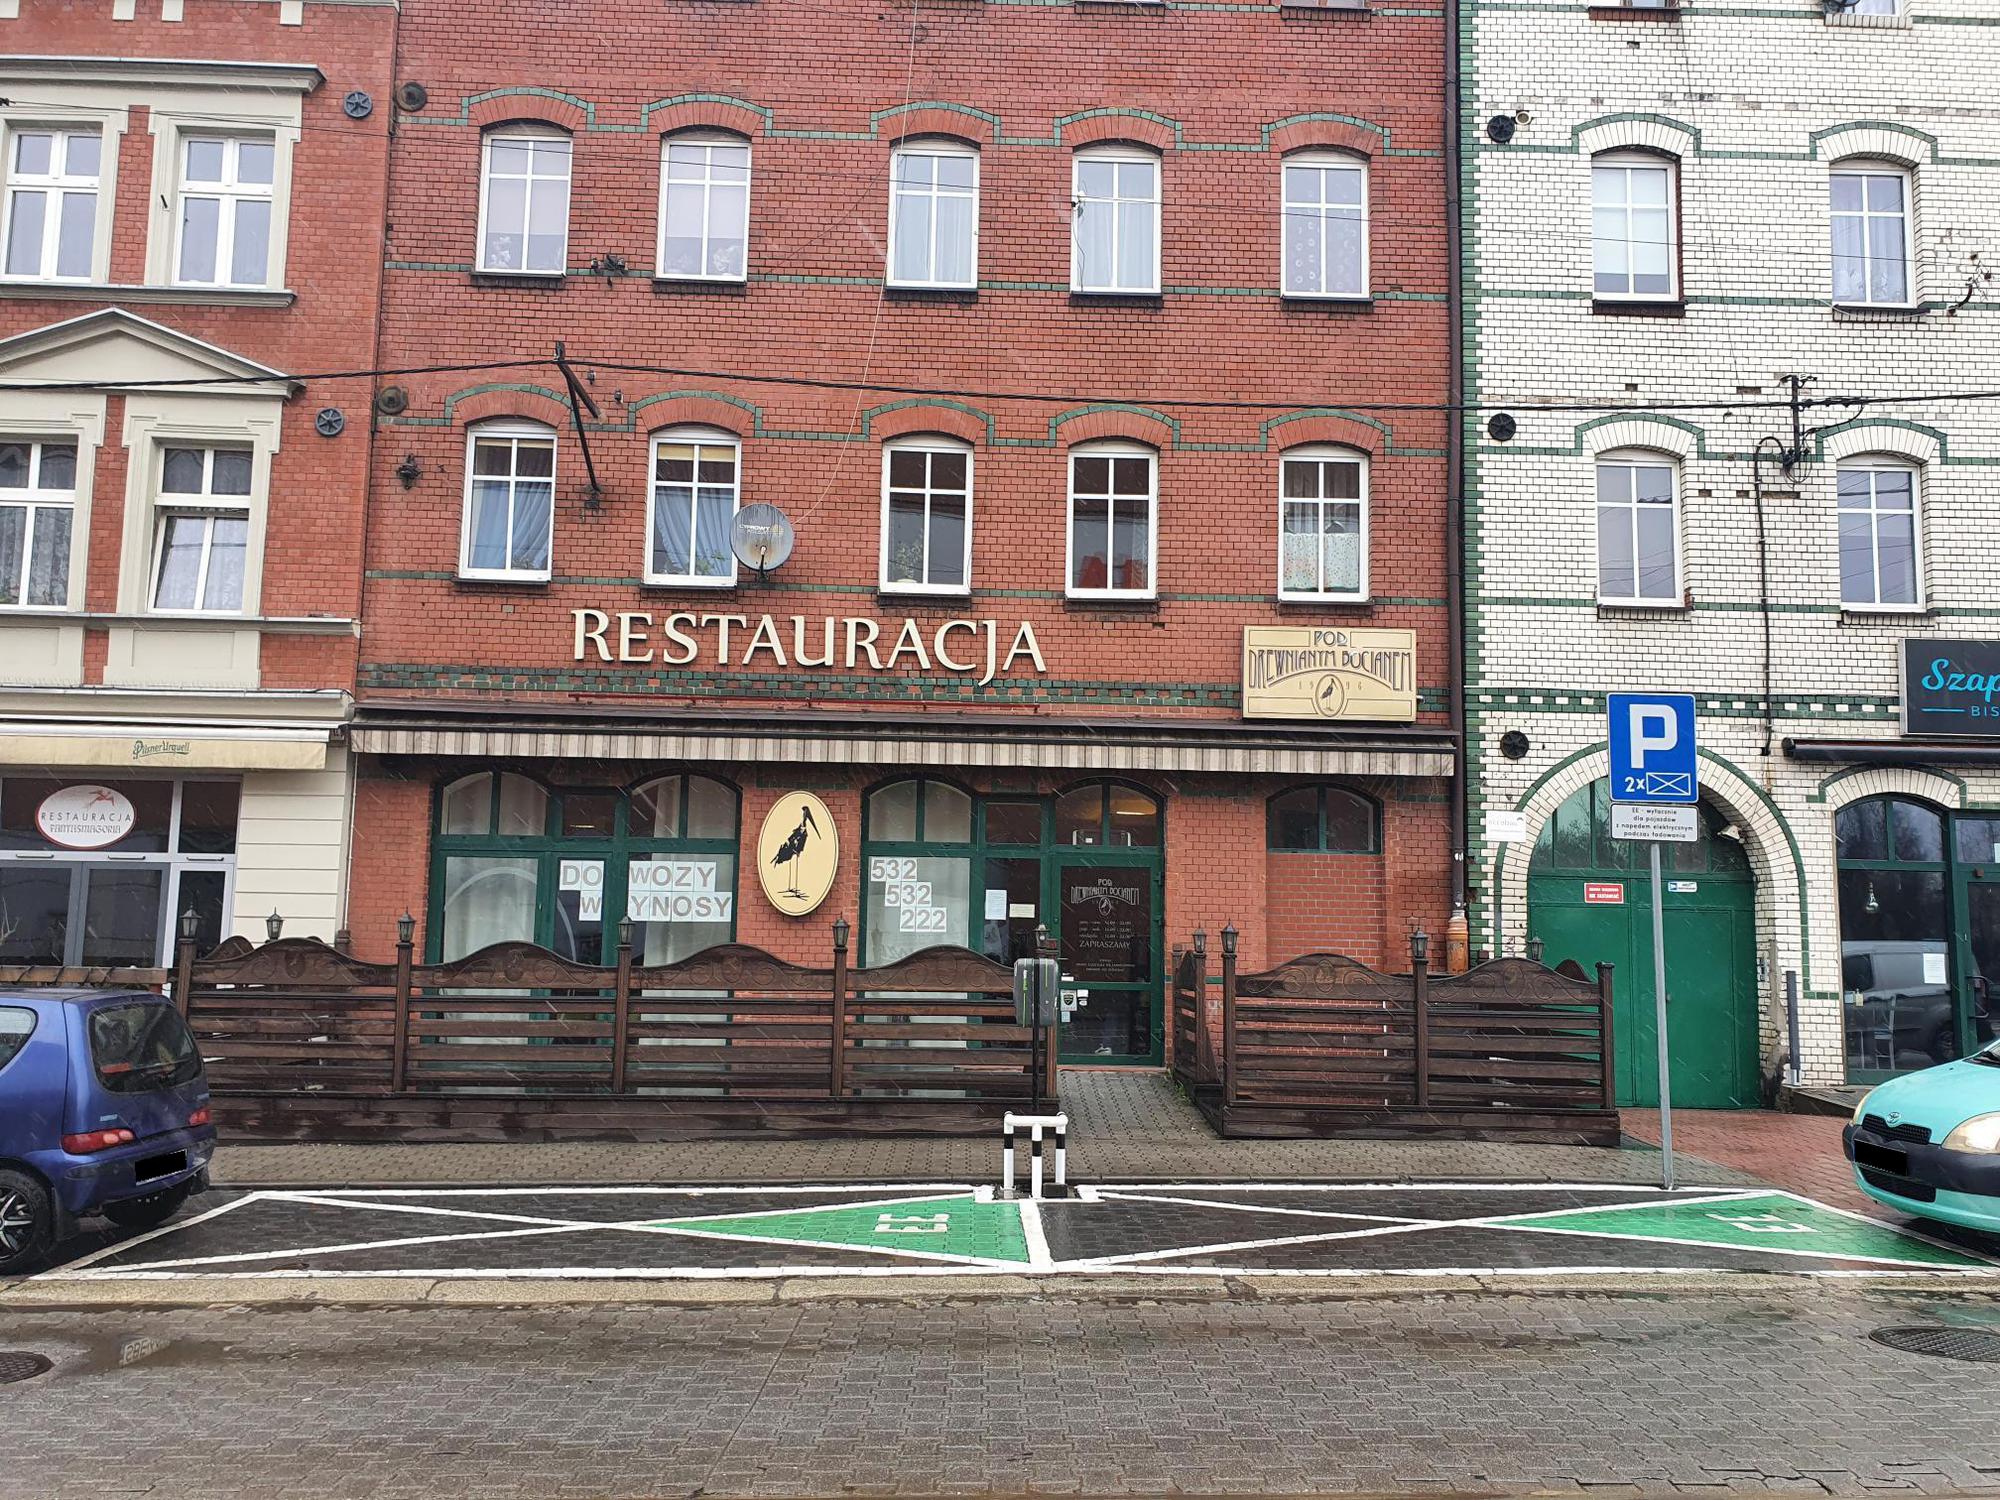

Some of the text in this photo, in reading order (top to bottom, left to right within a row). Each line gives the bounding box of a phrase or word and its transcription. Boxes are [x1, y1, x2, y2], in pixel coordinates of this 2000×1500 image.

[570, 609, 1047, 687] RESTAURACJA
[1313, 630, 1348, 647] POD
[1248, 649, 1413, 692] DREWNIANYM BOCIANEM
[1628, 703, 1678, 769] P
[41, 812, 132, 822] RESTAURACJA
[871, 859, 917, 880] 532
[886, 884, 931, 905] 532
[900, 909, 946, 930] 222
